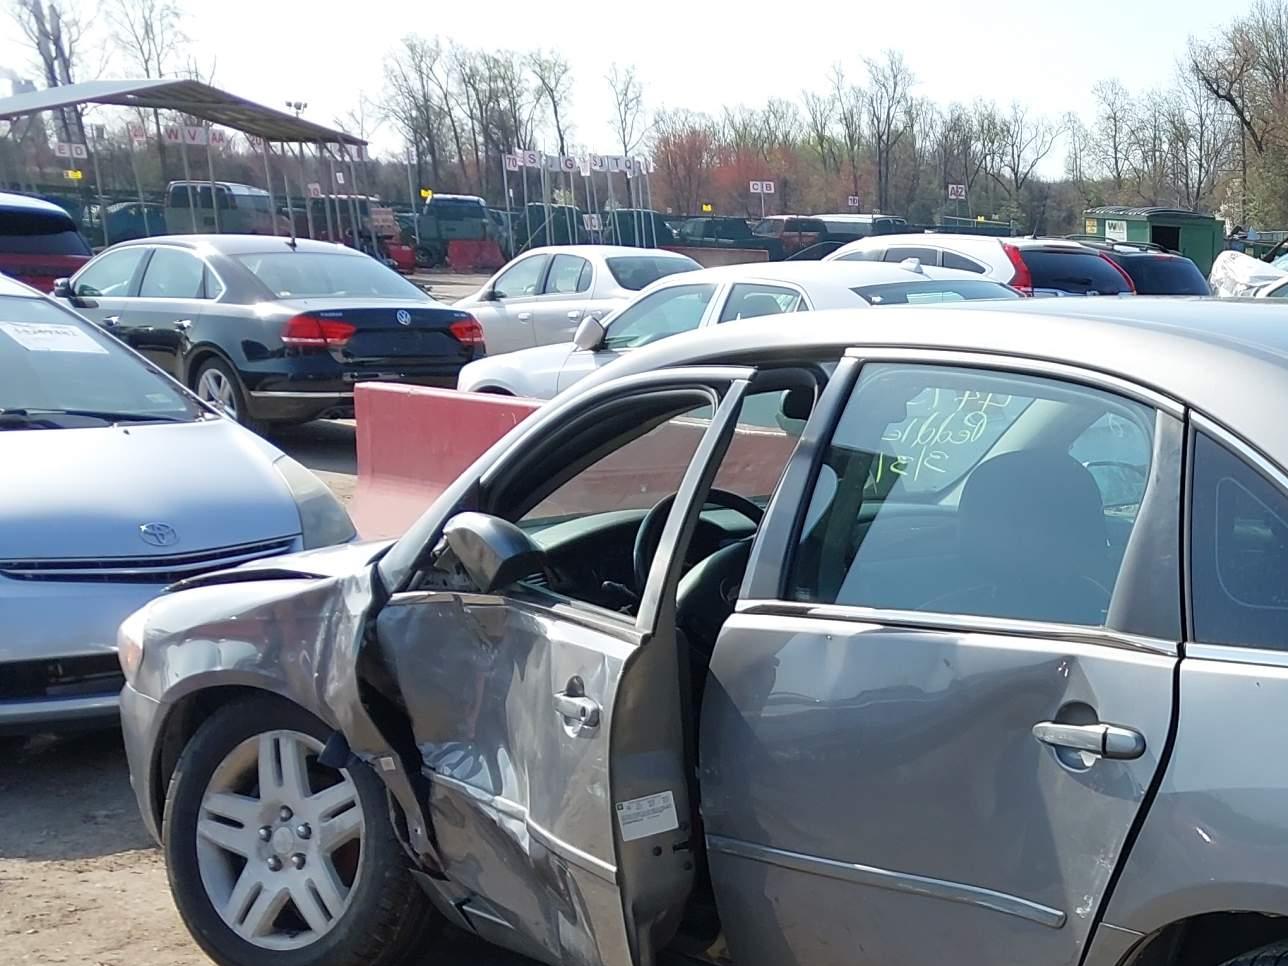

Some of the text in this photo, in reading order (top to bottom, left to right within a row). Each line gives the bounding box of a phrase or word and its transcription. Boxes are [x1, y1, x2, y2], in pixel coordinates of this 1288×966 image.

[528, 154, 537, 164] S
[565, 158, 574, 169] G
[752, 183, 772, 191] C B
[950, 186, 956, 196] A
